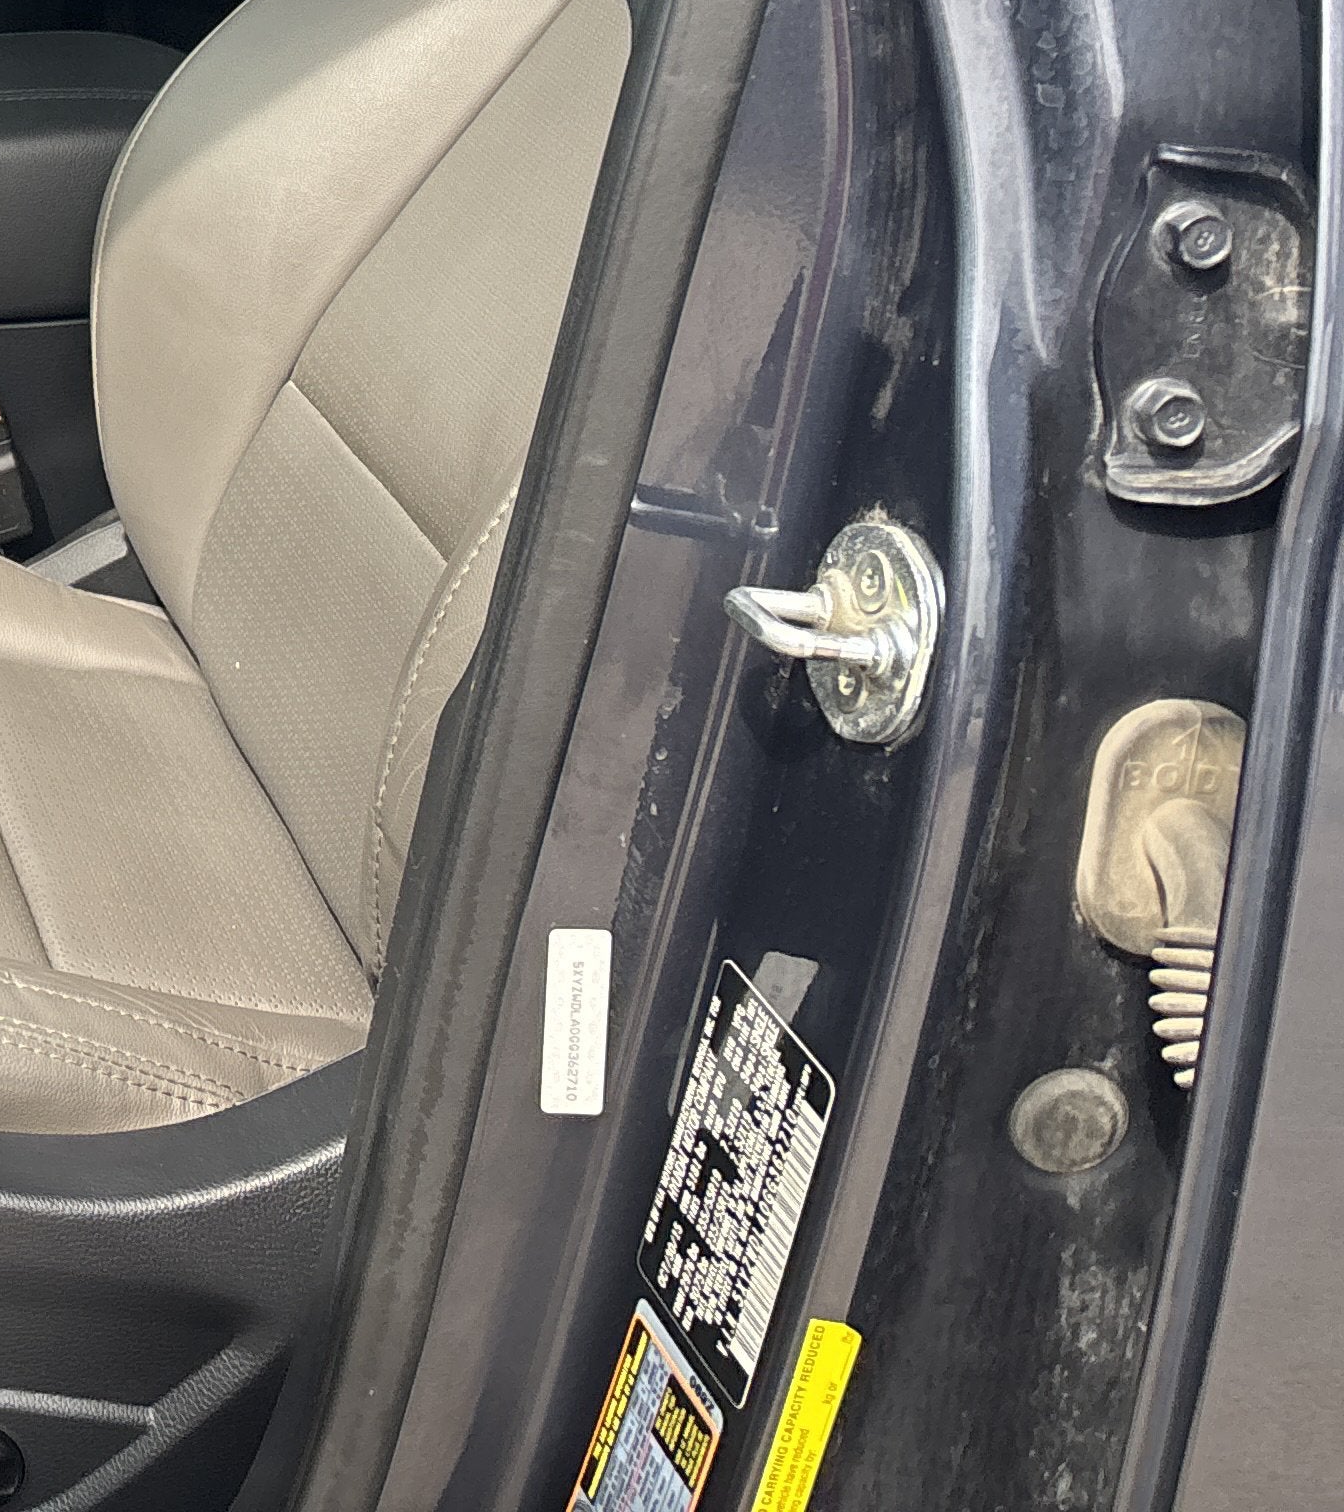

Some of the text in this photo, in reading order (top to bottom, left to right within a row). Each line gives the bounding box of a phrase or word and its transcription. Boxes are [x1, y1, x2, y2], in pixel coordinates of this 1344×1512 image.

[1118, 762, 1240, 794] BOD
[667, 1148, 688, 1202] HYUNDAI
[680, 1108, 701, 1152] MOTOR
[694, 1048, 717, 1110] COMPANY
[762, 1326, 825, 1505] CARRYING CAPACITY REDUCED
[785, 1462, 798, 1487] have
[793, 1429, 809, 1462] reduced
[795, 1465, 811, 1497] capacity
[822, 1394, 835, 1405] kg
[829, 1383, 837, 1392] or
